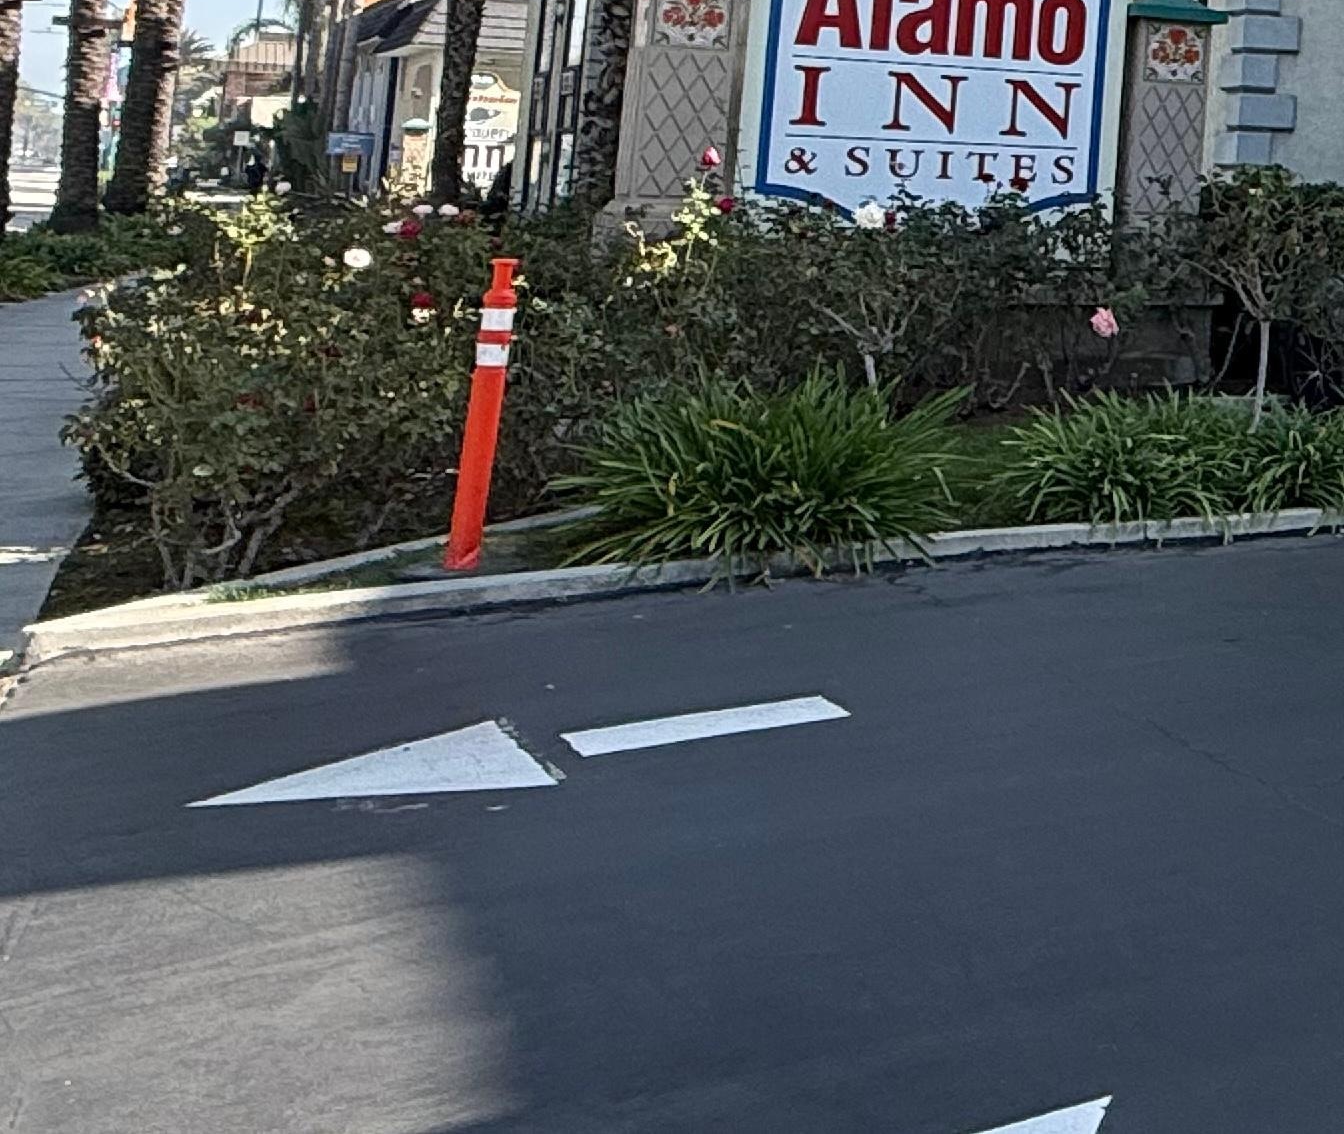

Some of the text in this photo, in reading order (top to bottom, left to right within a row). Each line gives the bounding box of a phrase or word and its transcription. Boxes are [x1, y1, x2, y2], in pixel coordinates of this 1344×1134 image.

[789, 65, 1082, 141] INN
[784, 146, 1075, 185] & SUITES
